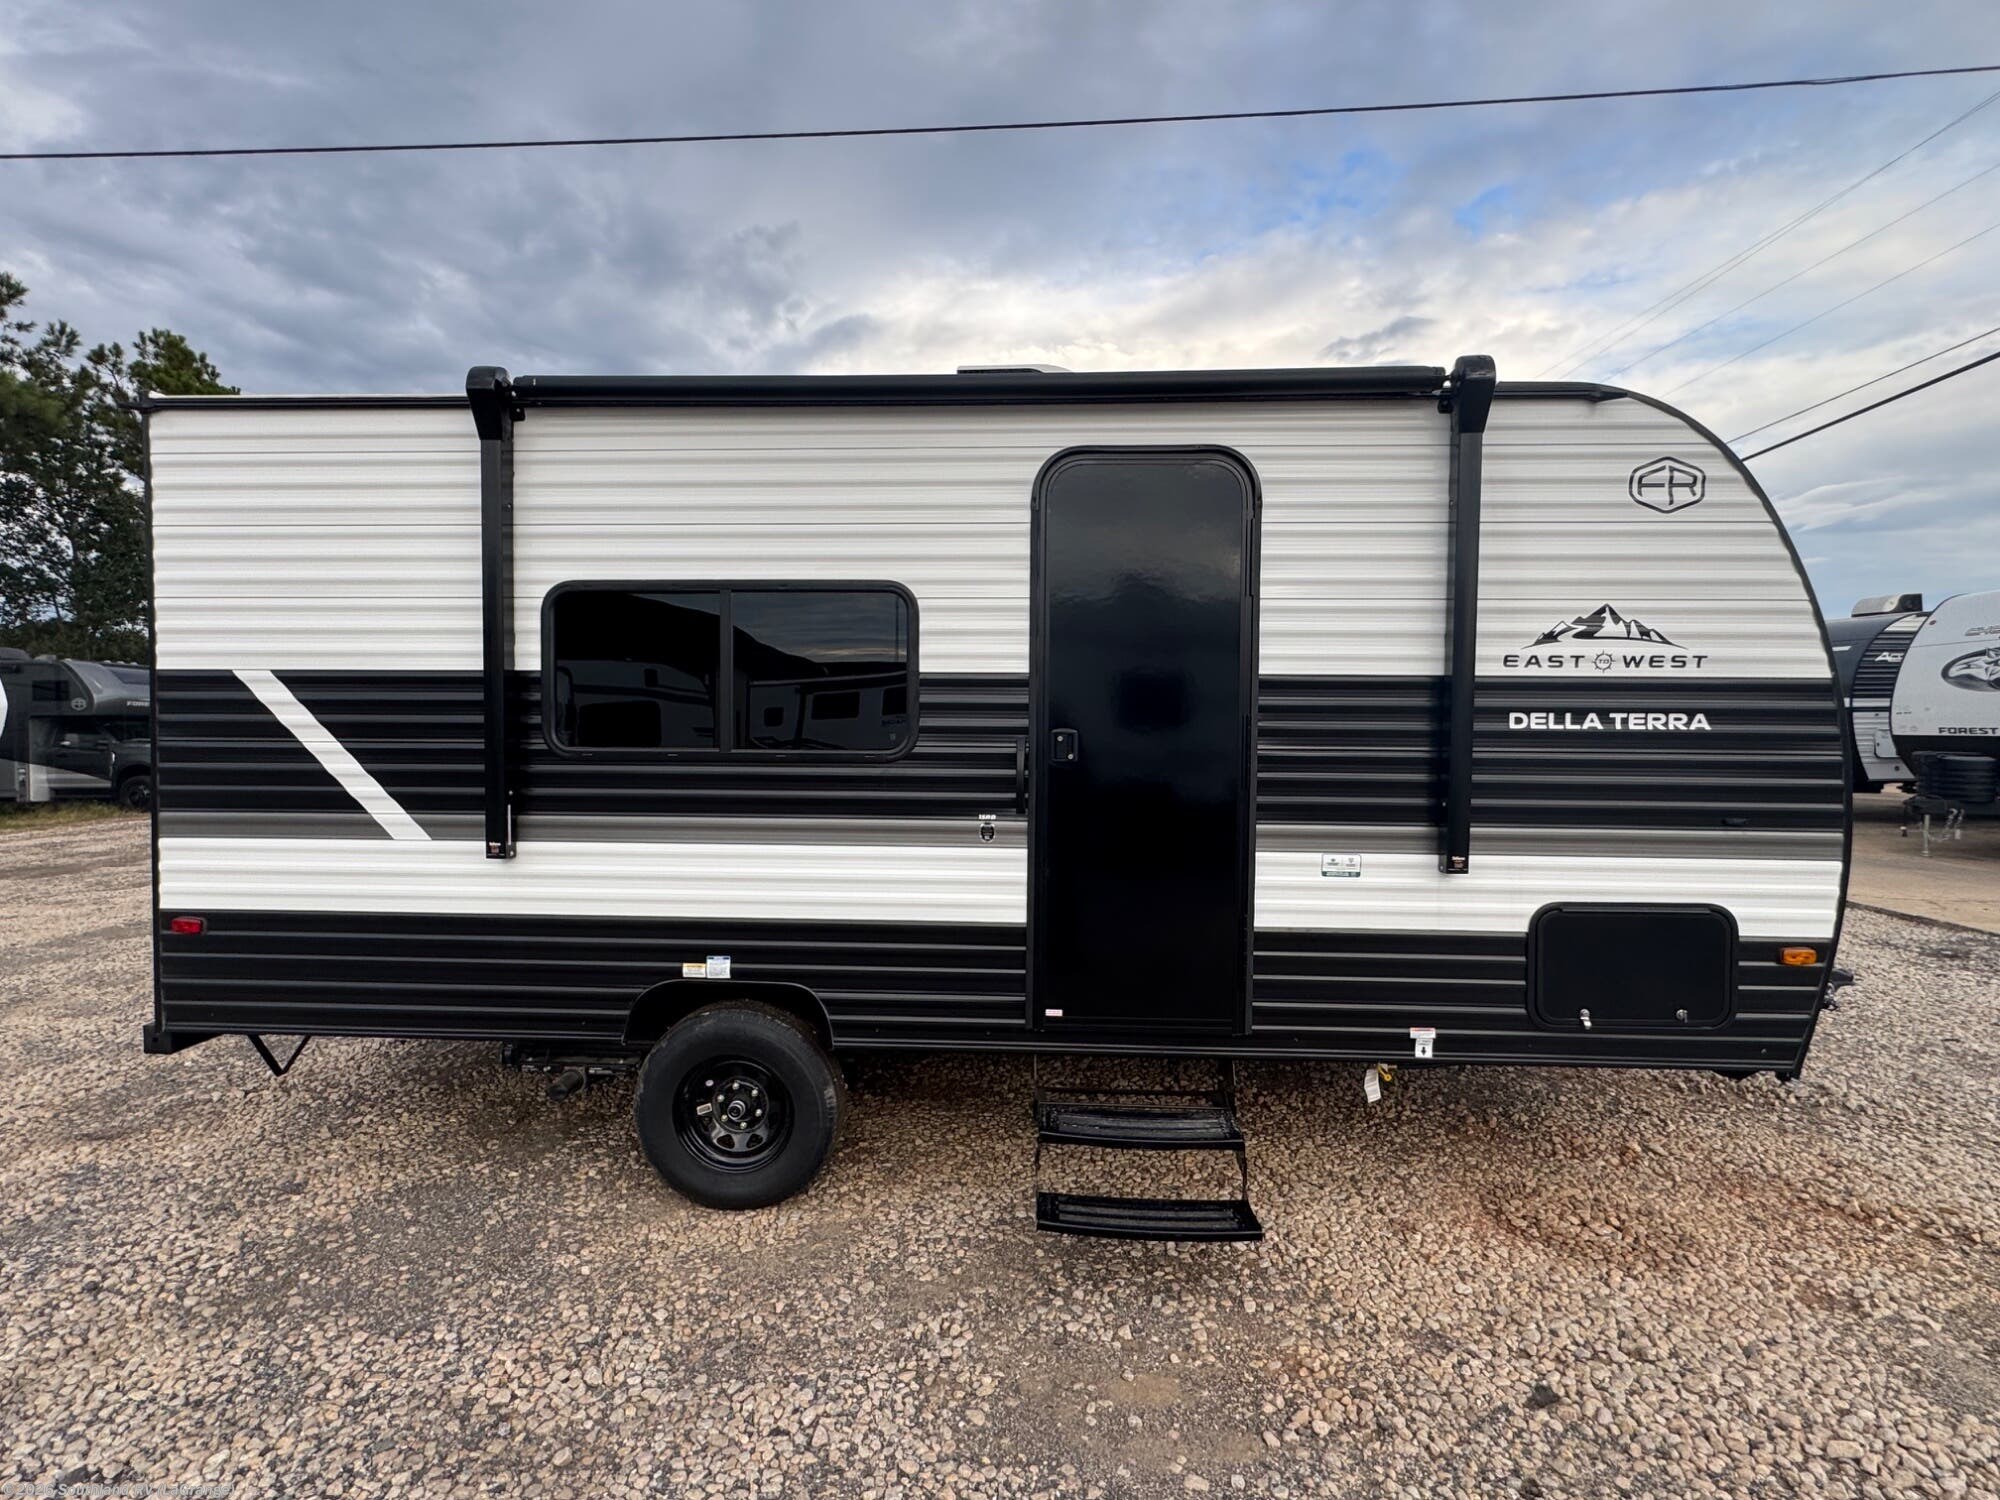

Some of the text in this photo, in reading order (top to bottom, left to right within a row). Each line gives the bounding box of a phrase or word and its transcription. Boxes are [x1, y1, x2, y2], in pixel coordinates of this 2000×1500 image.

[1503, 654, 1586, 668] EAST
[1622, 654, 1709, 668] WEST
[1508, 712, 1712, 731] DELLA TERRA
[1938, 726, 1999, 735] FOREST
